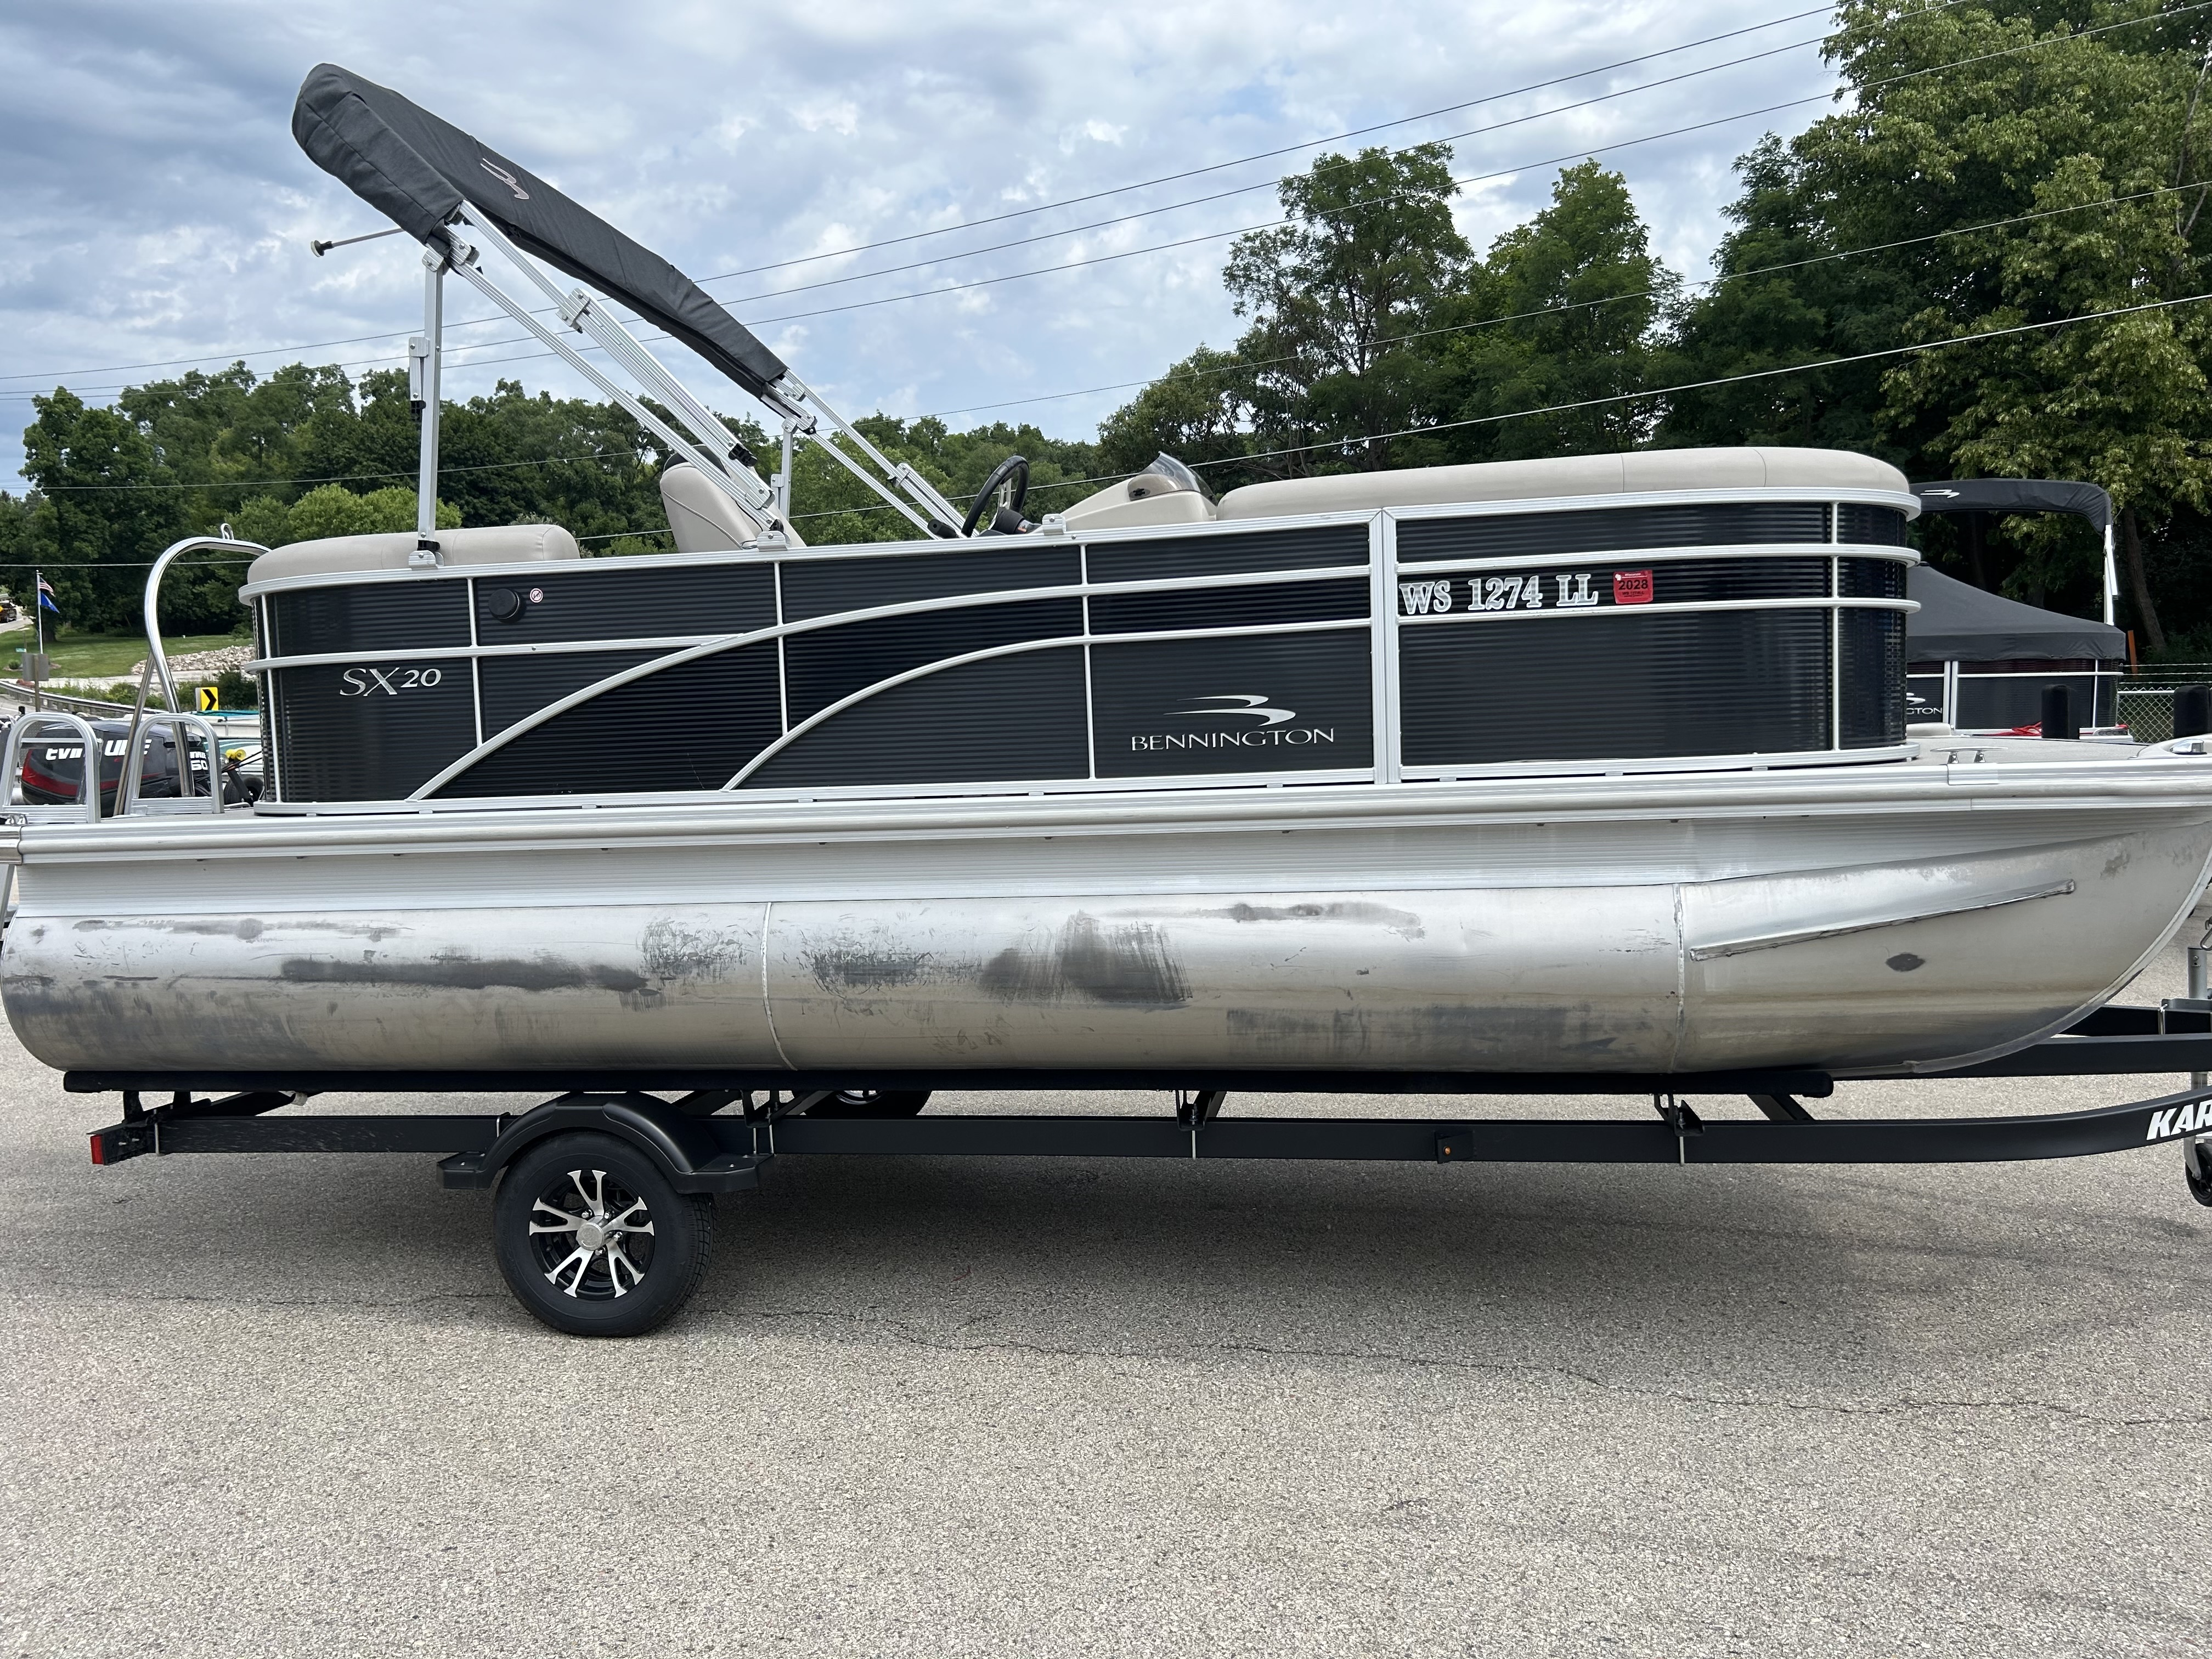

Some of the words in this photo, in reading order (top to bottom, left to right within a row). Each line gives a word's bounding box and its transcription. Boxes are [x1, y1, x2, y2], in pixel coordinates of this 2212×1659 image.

[1398, 580, 1451, 614] WS
[1468, 575, 1543, 610] 1274
[1556, 574, 1599, 606] LL
[1618, 579, 1648, 590] 2028
[1131, 727, 1335, 751] BENNINGTON
